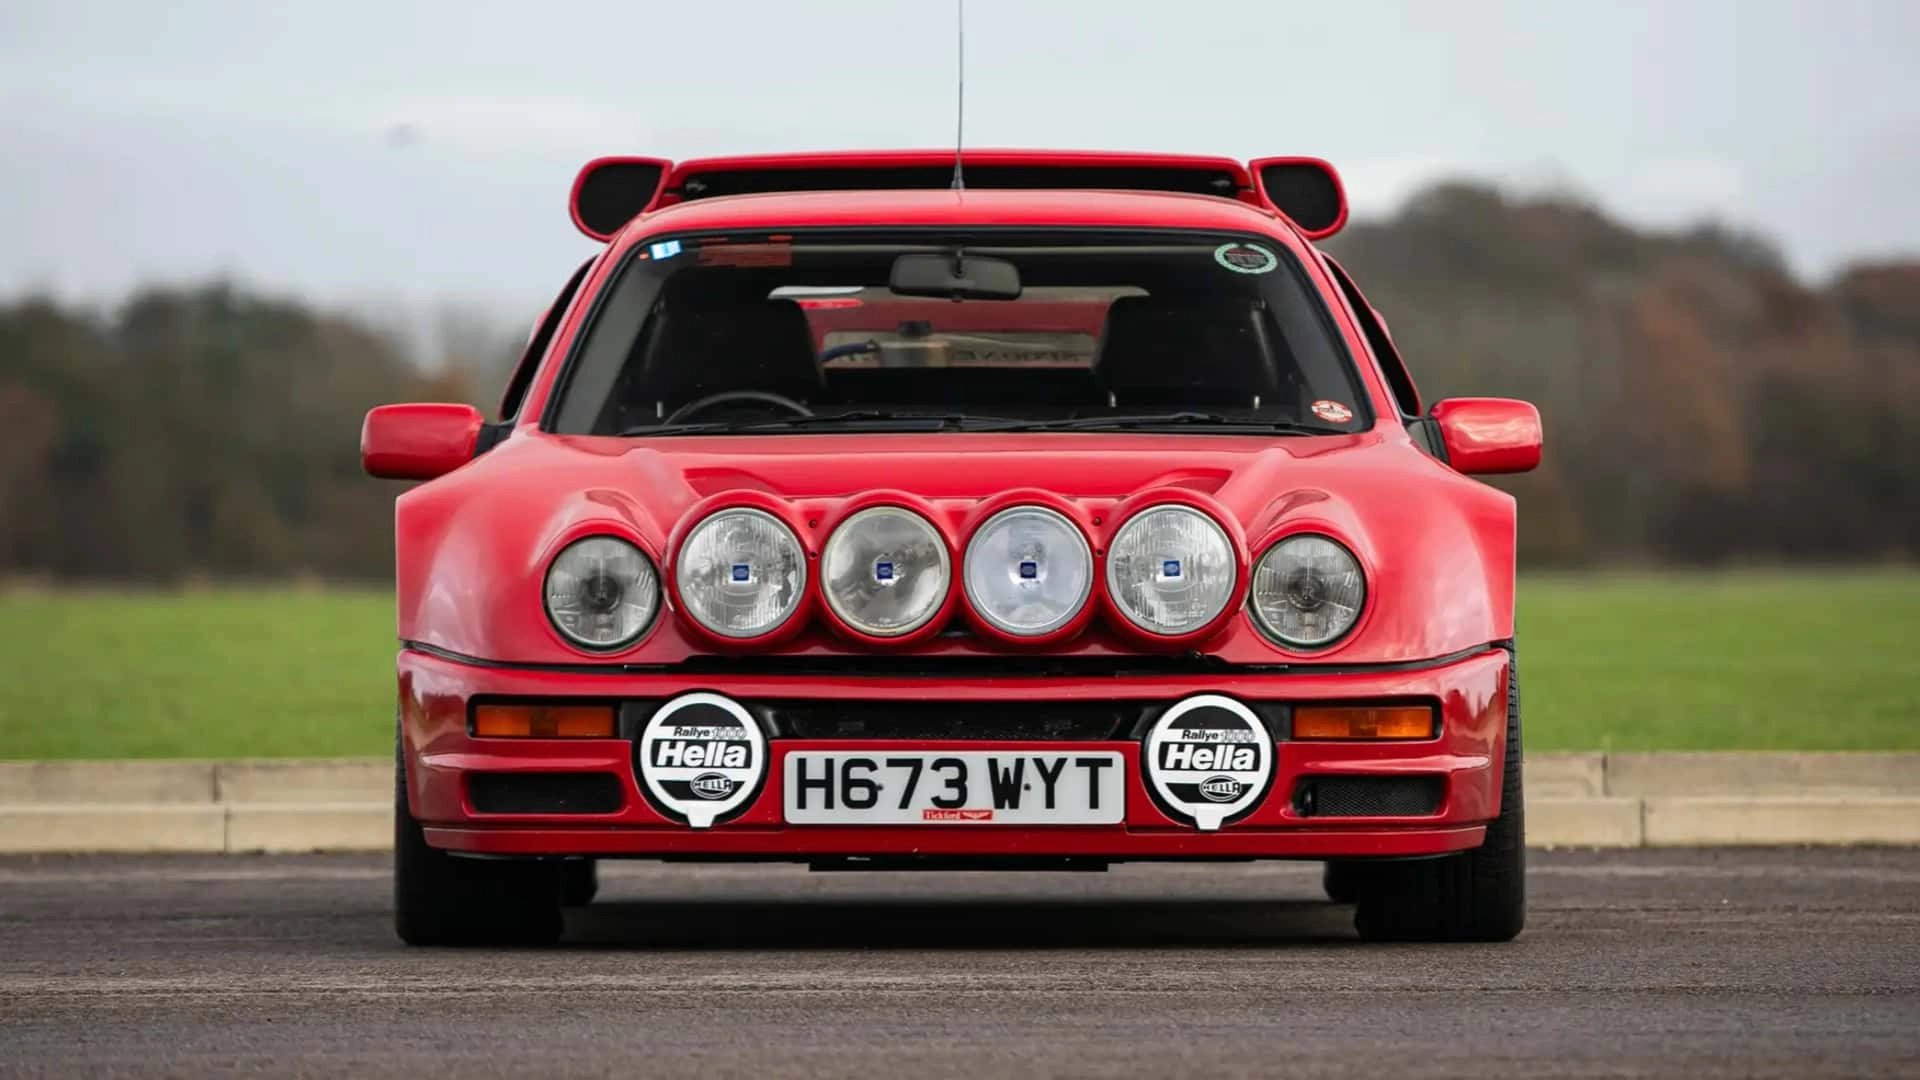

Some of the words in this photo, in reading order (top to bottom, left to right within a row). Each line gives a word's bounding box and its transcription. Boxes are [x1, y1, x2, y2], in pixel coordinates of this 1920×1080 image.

[673, 727, 711, 739] Rallye
[1181, 729, 1220, 742] Rallye
[656, 741, 747, 768] Hella
[1164, 743, 1256, 771] Hella
[693, 778, 733, 793] HELLA
[796, 758, 968, 809] H673
[987, 758, 1113, 809] WYT
[1202, 781, 1241, 795] HELLA
[925, 810, 961, 820] Tickford
